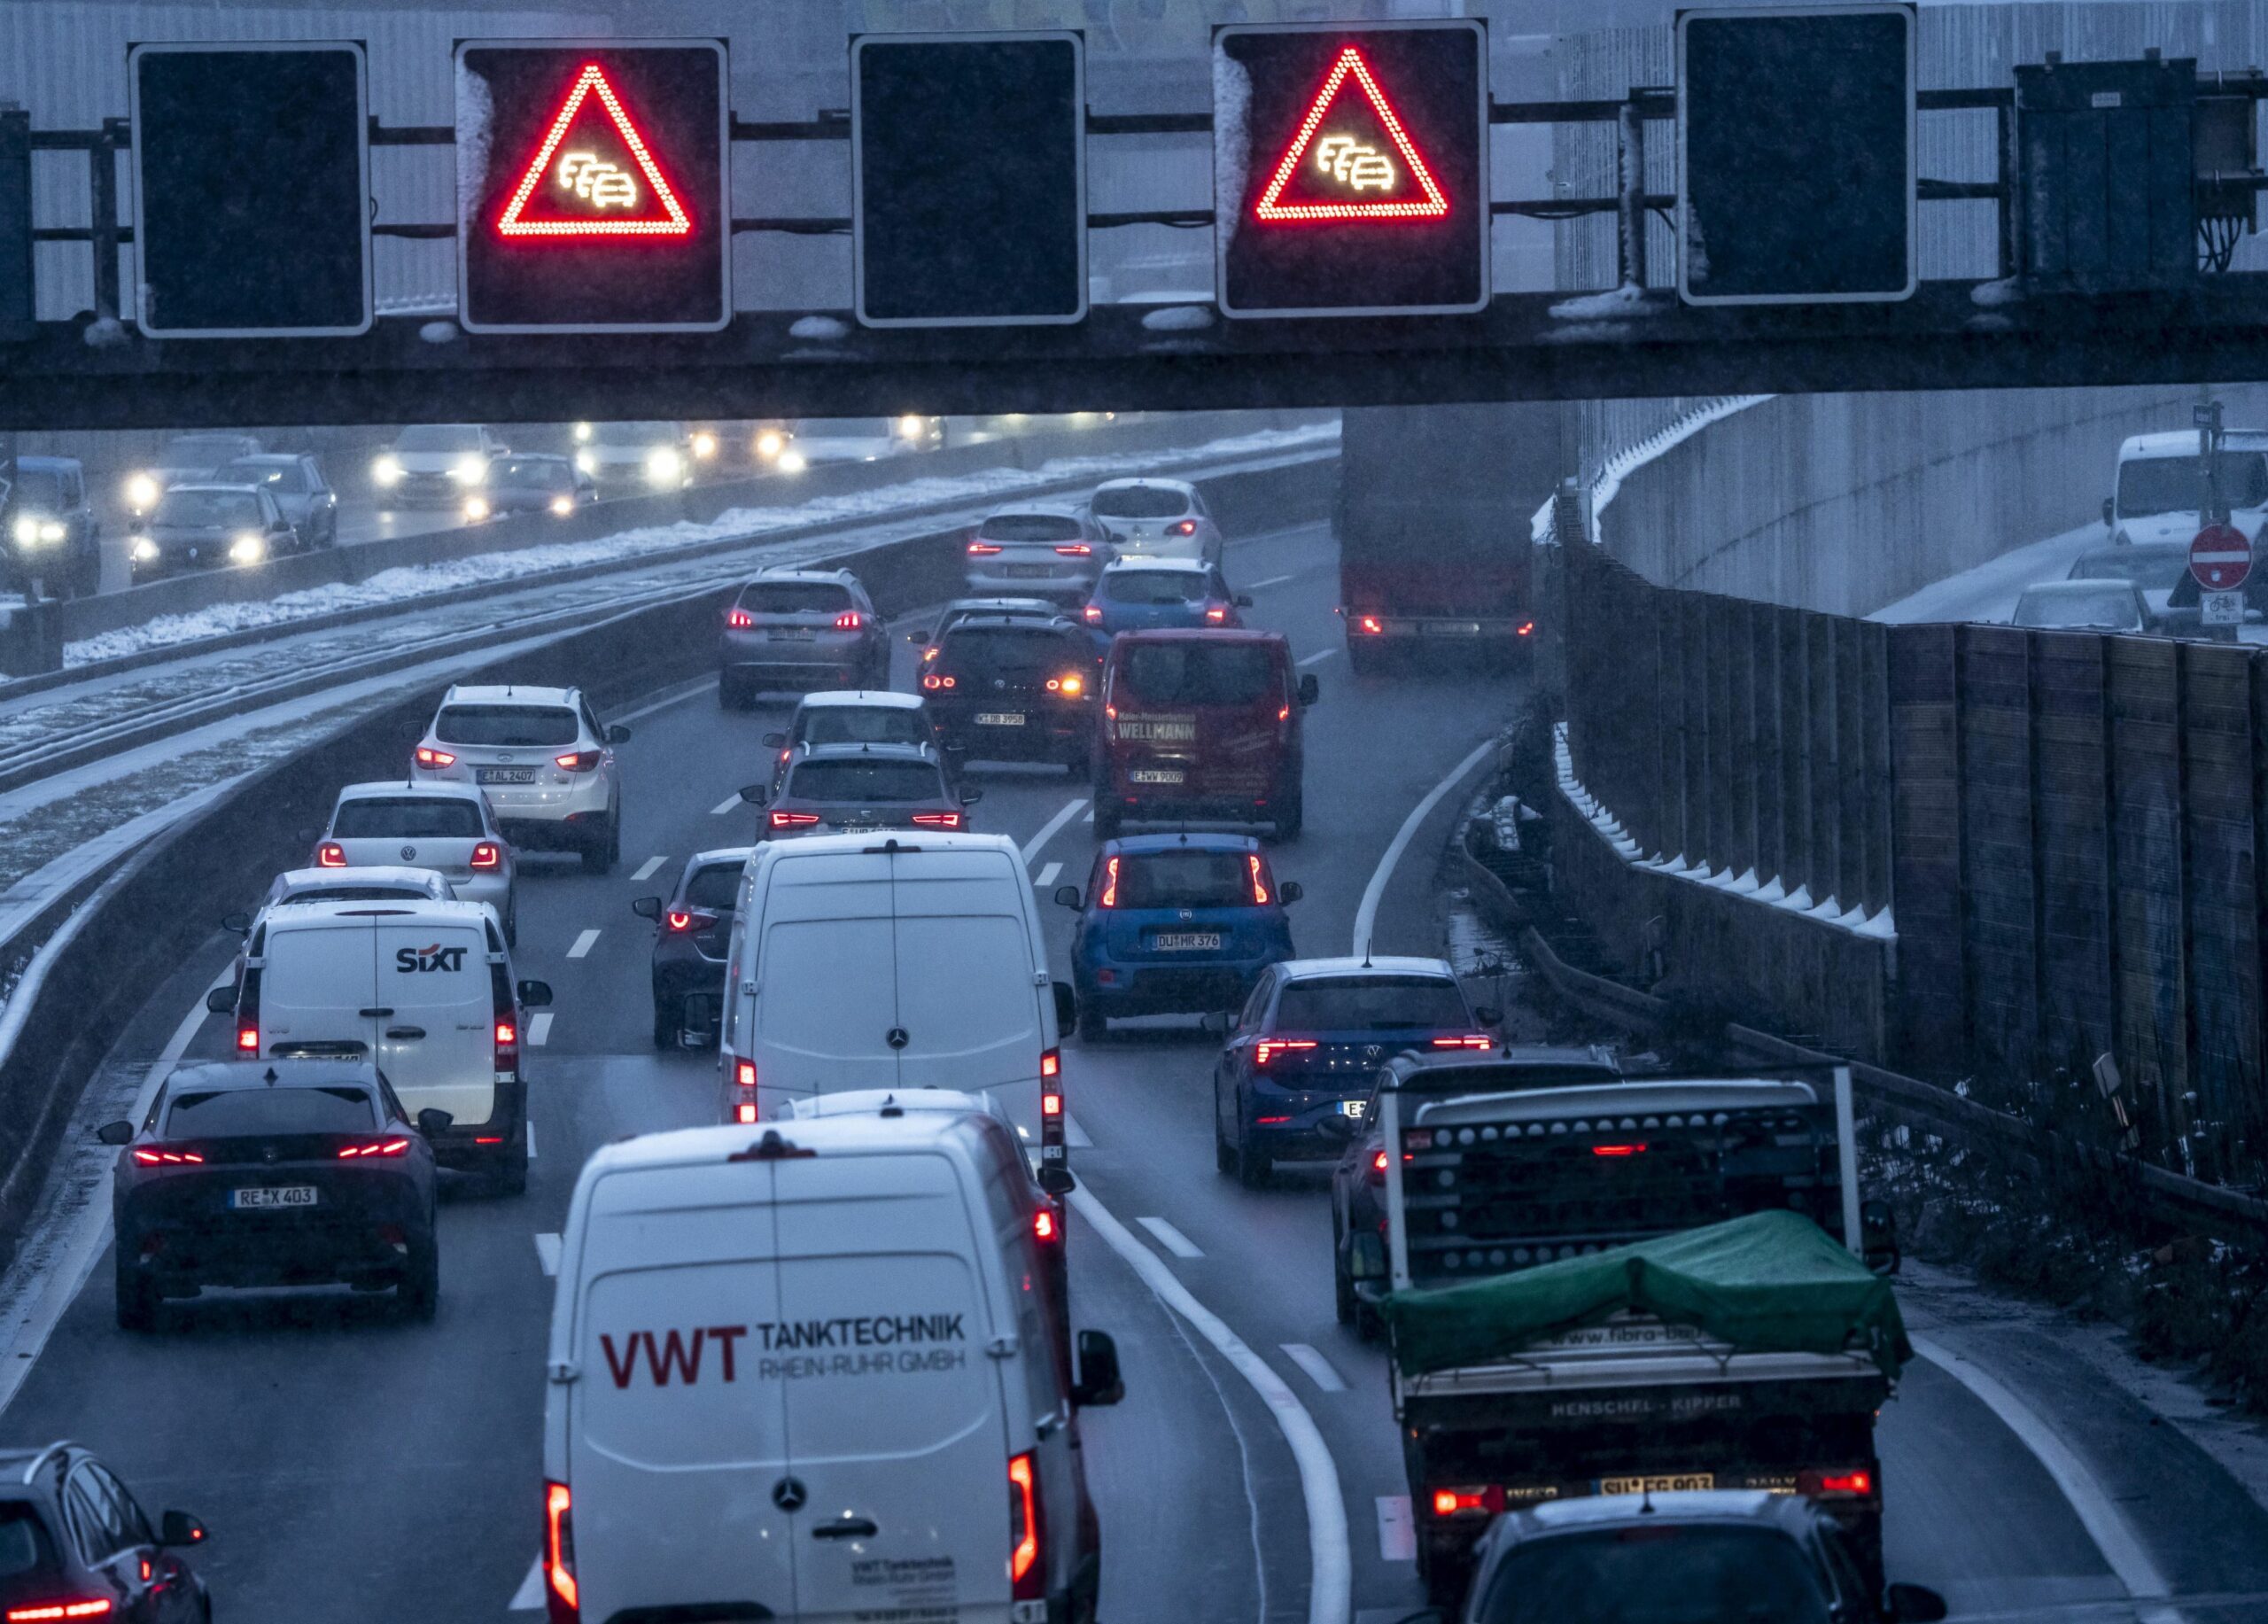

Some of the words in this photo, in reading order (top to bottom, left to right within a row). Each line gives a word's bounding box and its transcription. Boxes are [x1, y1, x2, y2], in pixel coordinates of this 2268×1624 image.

[1119, 723, 1195, 740] WELLMANN
[1159, 936, 1173, 947] DU
[1198, 935, 1219, 946] 376
[1349, 1103, 1358, 1115] E
[241, 1191, 260, 1205] RE
[271, 1189, 280, 1204] X
[284, 1189, 312, 1203] 403
[756, 1312, 966, 1350] TANKTECHNIK
[600, 1325, 748, 1389] VWT
[758, 1350, 894, 1380] RHEIN-RUHR
[1552, 1399, 1653, 1417] HENSCHEL
[1671, 1395, 1742, 1411] KIPPER
